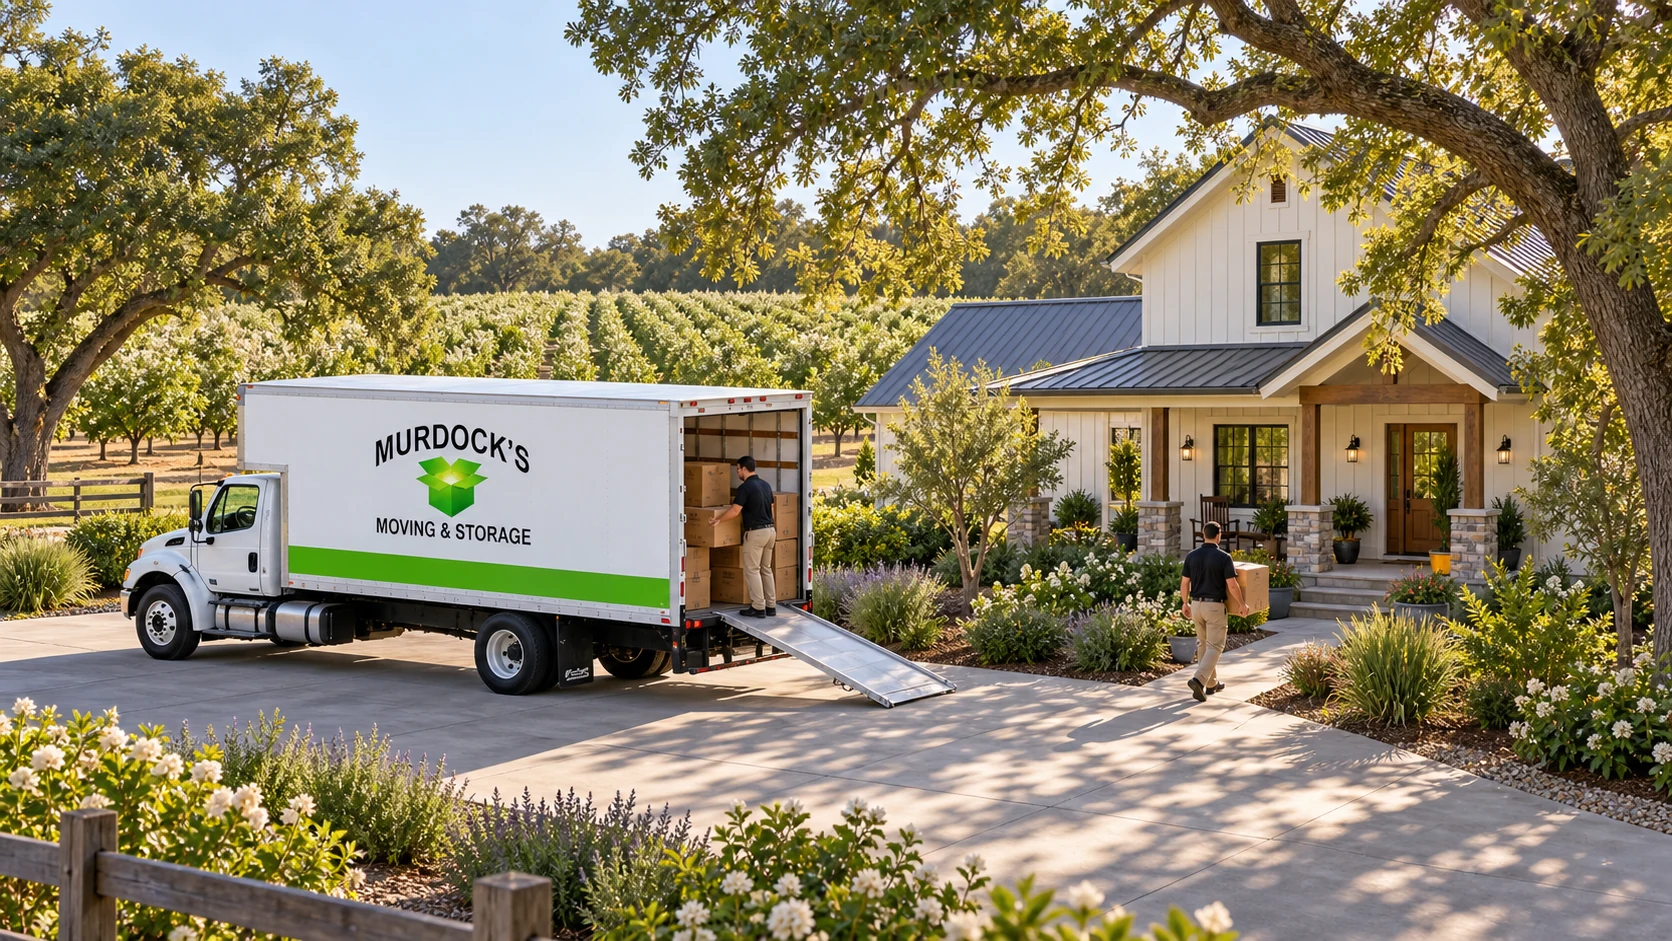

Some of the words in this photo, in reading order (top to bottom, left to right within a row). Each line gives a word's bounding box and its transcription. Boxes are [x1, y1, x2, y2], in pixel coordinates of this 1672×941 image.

[375, 424, 530, 474] MURDOCK'S
[376, 517, 436, 538] MOVING
[440, 522, 451, 539] &
[455, 523, 532, 546] STORAGE
